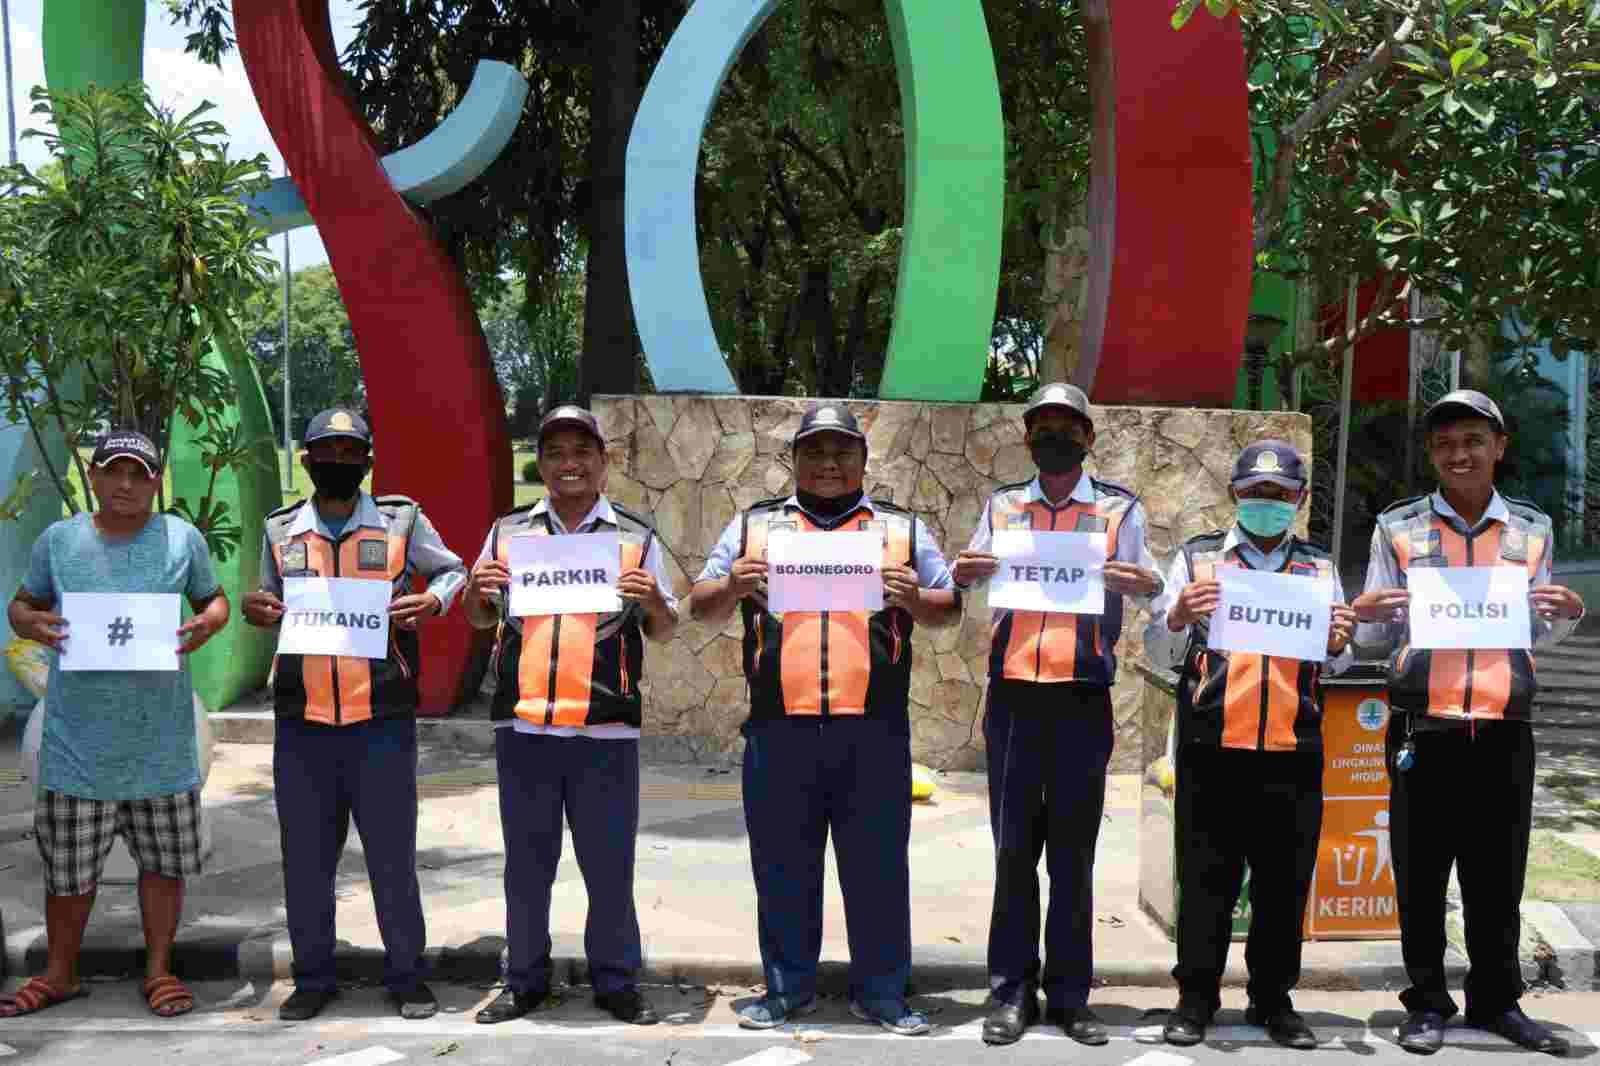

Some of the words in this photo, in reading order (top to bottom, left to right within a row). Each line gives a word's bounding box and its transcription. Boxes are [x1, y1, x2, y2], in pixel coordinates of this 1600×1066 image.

[522, 567, 608, 588] PARKIR
[775, 563, 874, 576] BOJONEGORO
[1009, 564, 1085, 584] TETAP
[290, 611, 381, 630] TUKANG
[1229, 605, 1312, 630] BUTUH
[1430, 602, 1509, 619] POLISI
[107, 616, 134, 646] #
[1319, 896, 1393, 917] KERIN
